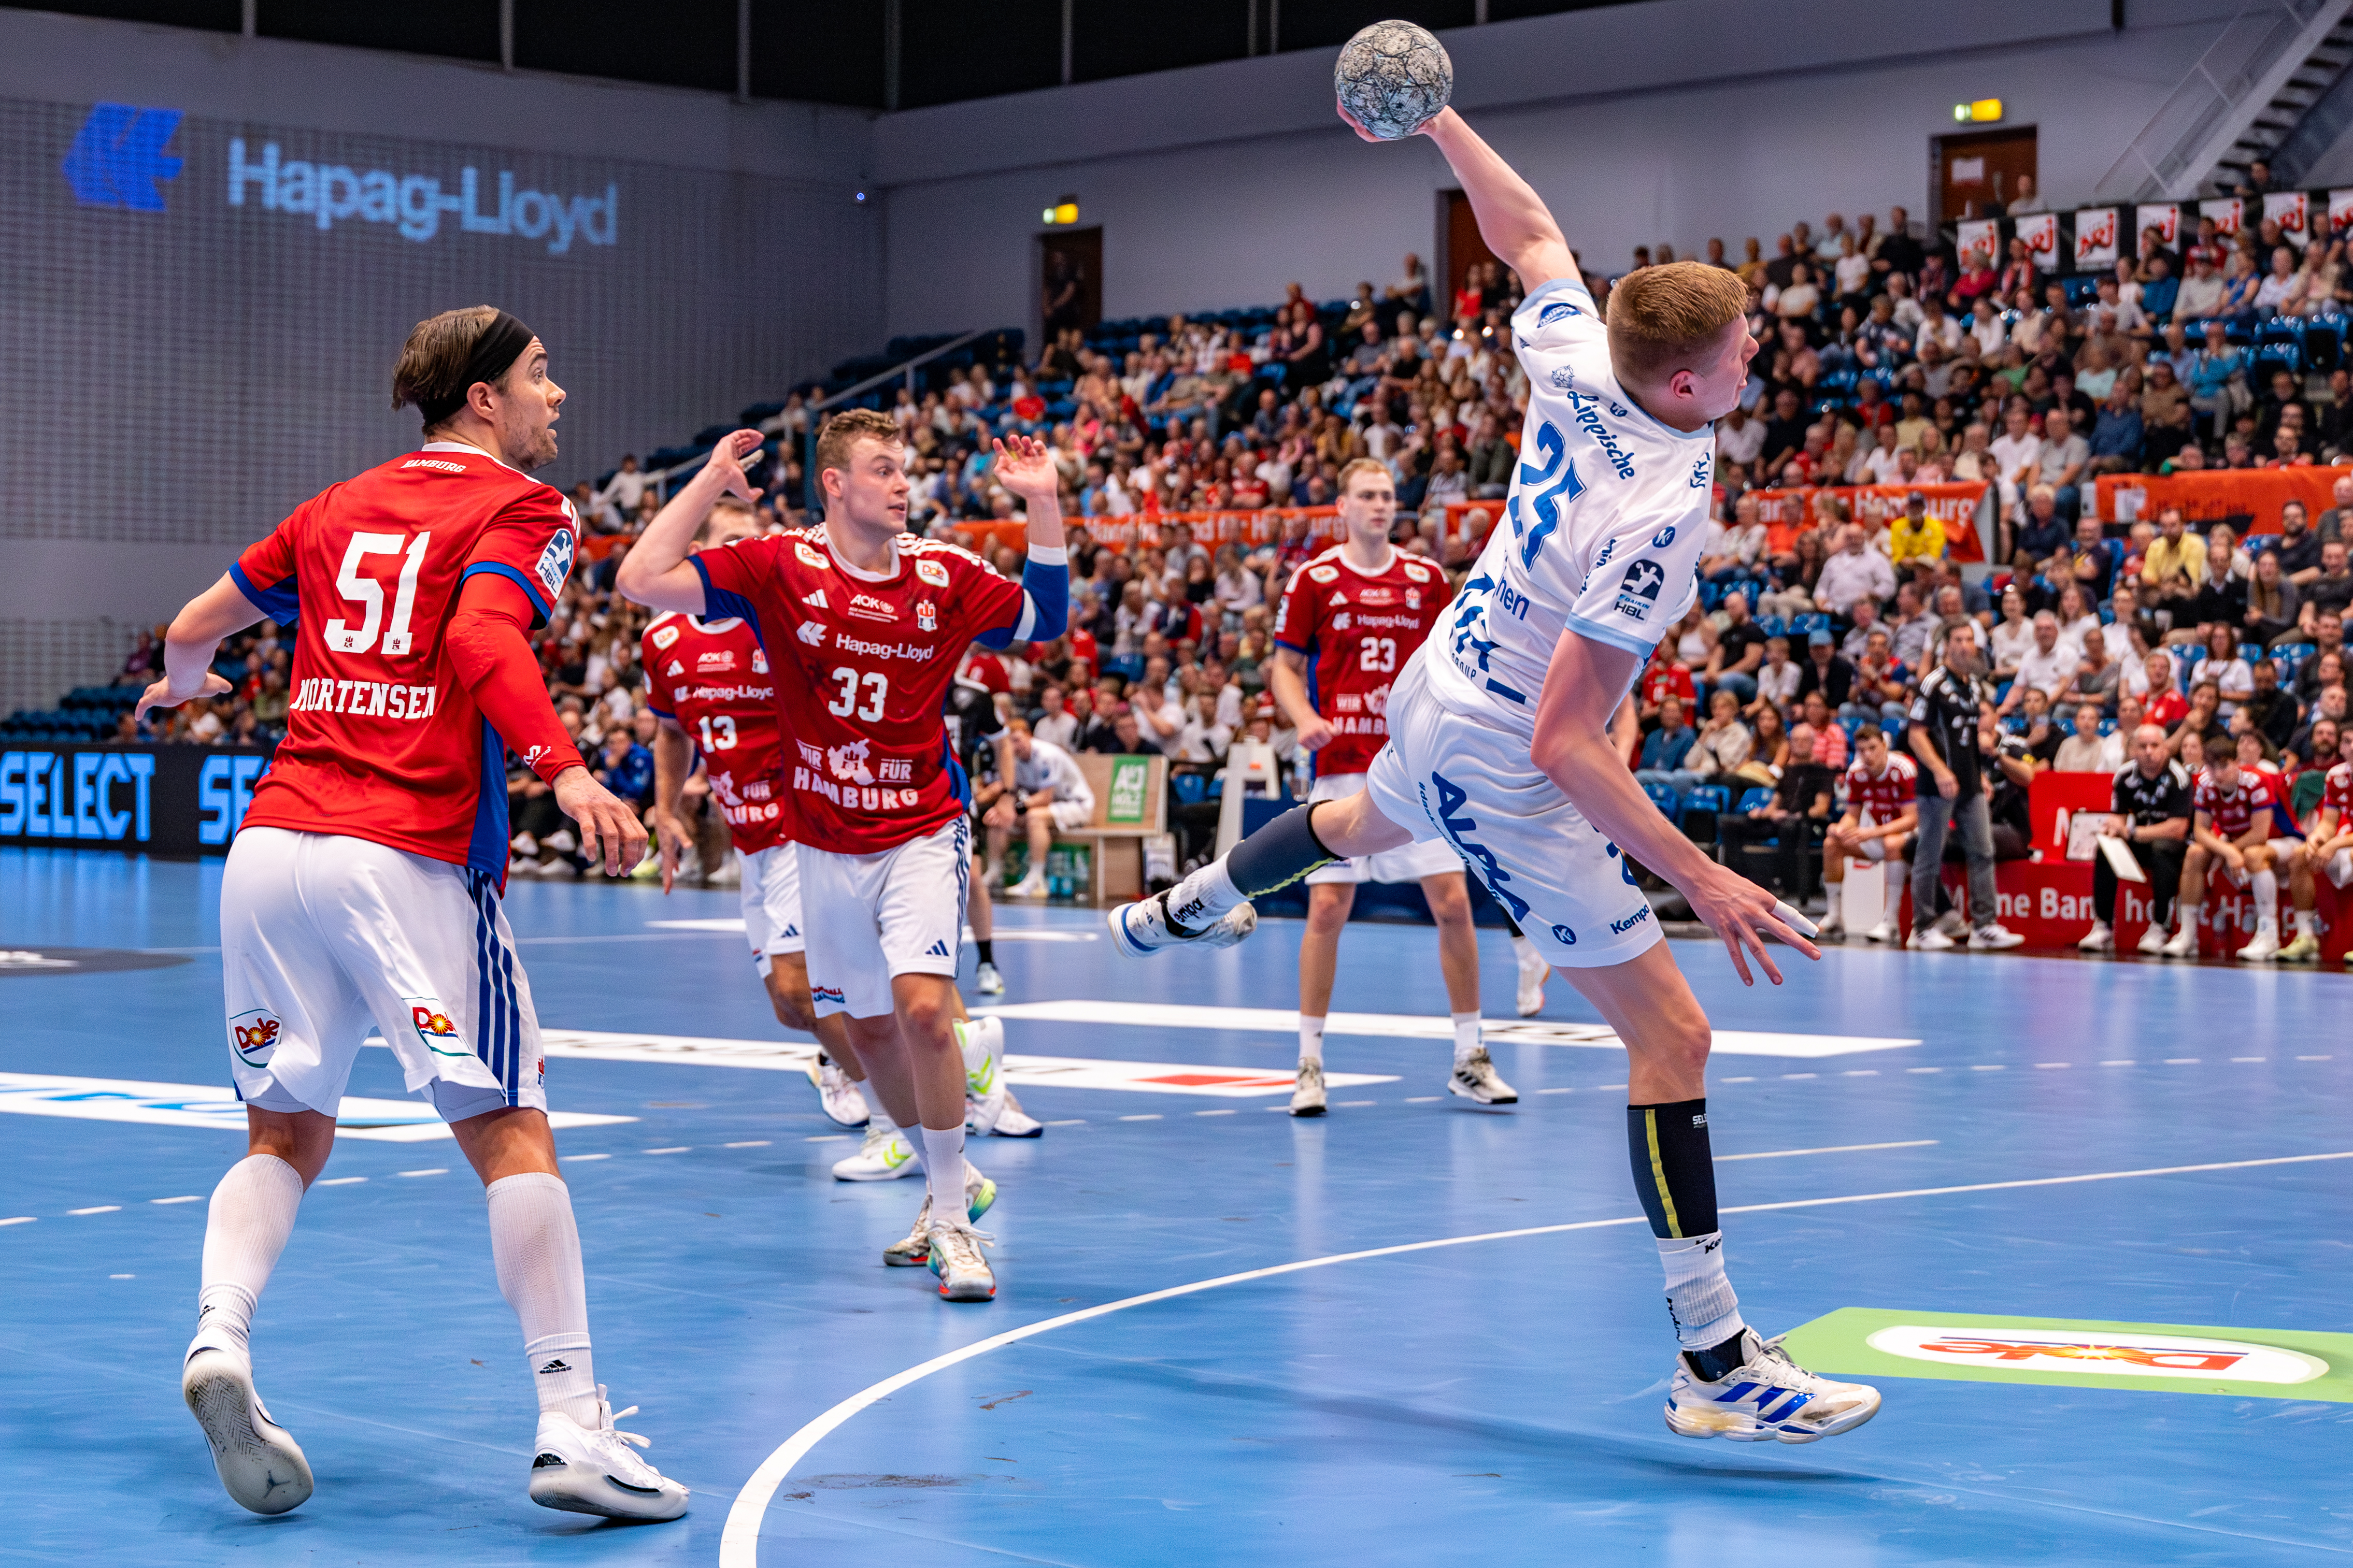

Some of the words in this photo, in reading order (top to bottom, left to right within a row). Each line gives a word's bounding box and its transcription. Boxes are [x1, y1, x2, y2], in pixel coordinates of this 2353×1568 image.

[228, 138, 617, 254] Hapag-Lloyd
[1567, 391, 1635, 480] Lippische
[401, 459, 466, 472] HAMBURG
[324, 531, 431, 655] 51
[539, 563, 557, 593] HBL
[850, 594, 880, 610] AOK
[1492, 575, 1530, 621] nen
[1614, 601, 1645, 621] HBL
[1624, 597, 1650, 610] DAIKIN
[835, 633, 934, 663] Hapag-Lloyd
[1360, 637, 1396, 673] 23
[290, 677, 437, 720] MORTENSEN
[829, 666, 889, 723] 33
[697, 715, 738, 754] 13
[879, 759, 912, 781] FÜR
[0, 751, 155, 842] SELECT
[793, 766, 919, 811] HAMBURG
[1174, 897, 1205, 923] empa
[1609, 903, 1650, 935] Kempa
[2040, 887, 2096, 920] Ban
[234, 1017, 280, 1049] Dole
[539, 1365, 572, 1374] adidas
[1918, 1341, 2244, 1371] Dole
